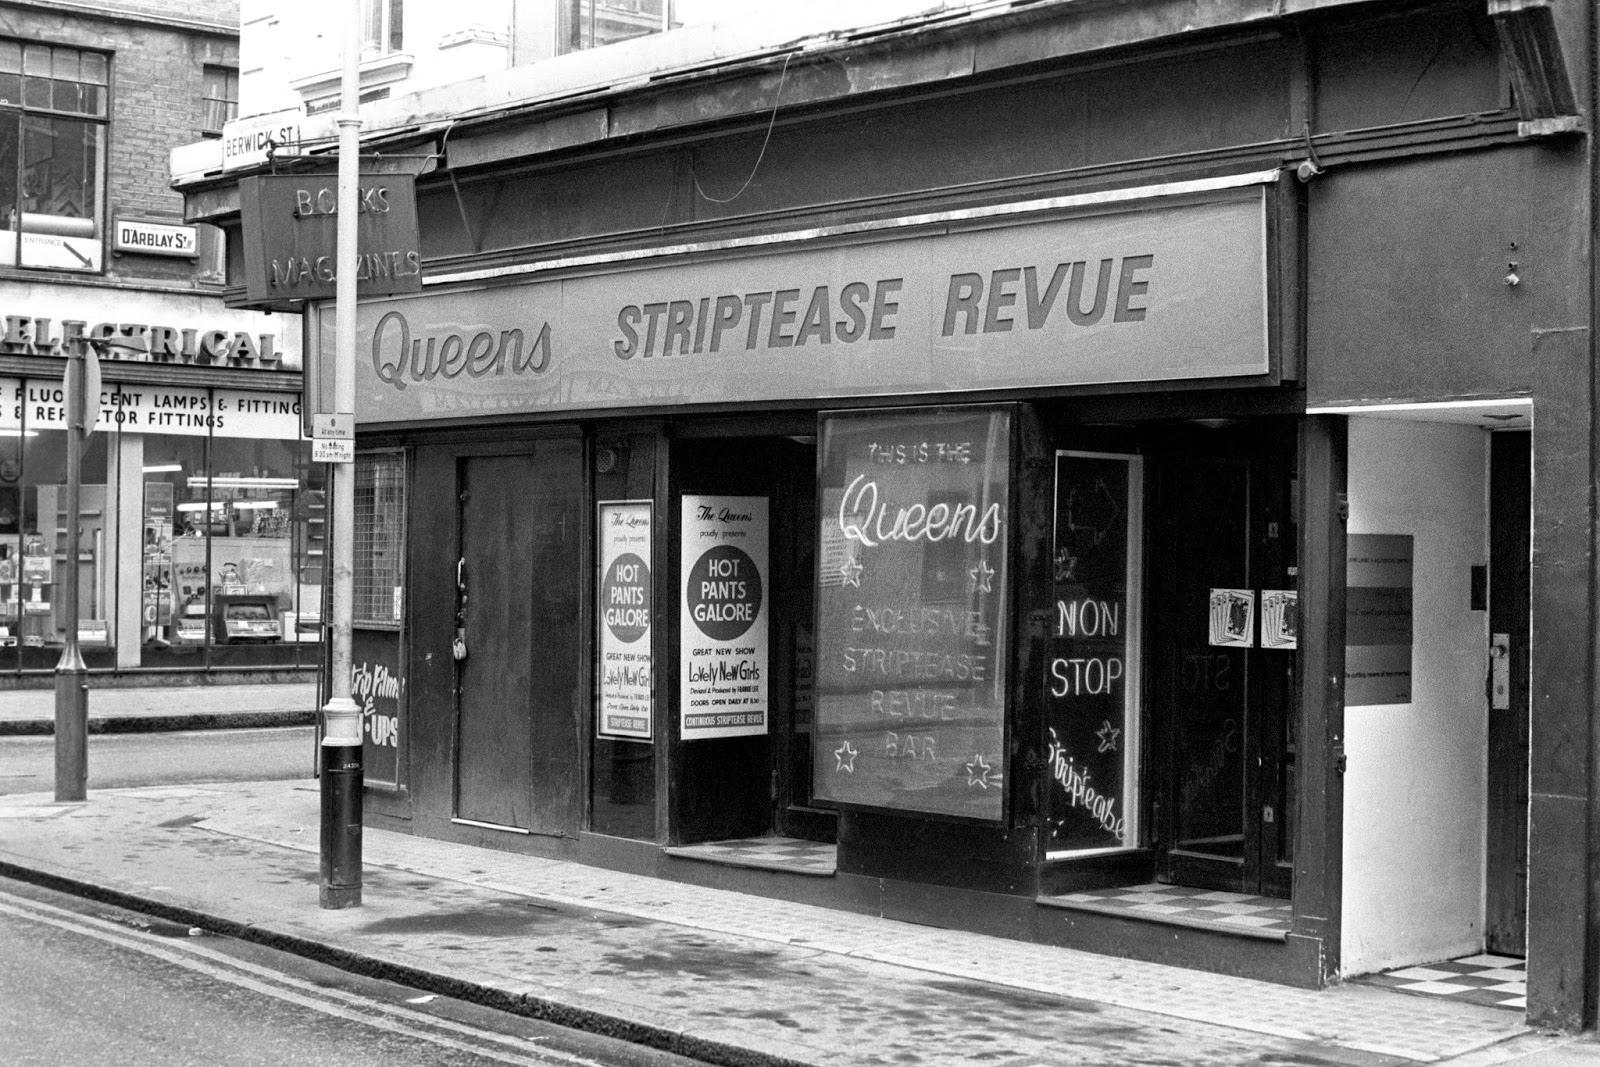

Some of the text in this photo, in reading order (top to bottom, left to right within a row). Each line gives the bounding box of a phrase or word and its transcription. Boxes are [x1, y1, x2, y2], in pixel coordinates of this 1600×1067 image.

[226, 130, 273, 158] BERWICK
[296, 187, 391, 217] BOKS
[24, 236, 63, 247] ENTRANCE
[271, 250, 420, 286] MAGZINES
[371, 253, 1155, 391] Queens STRIPTEASE REVUE
[3, 314, 283, 362] ELCTRICAL
[15, 387, 142, 407] FLUOCENT
[154, 394, 207, 410] LAMPS
[218, 398, 228, 411] &
[36, 406, 138, 424] REFTOR
[148, 411, 225, 428] FITTINGS
[697, 505, 752, 523] The Queens
[839, 474, 1001, 547] Queens
[700, 530, 718, 540] proudly
[616, 564, 639, 582] HOT
[708, 558, 741, 577] HOT
[611, 586, 644, 605] PANTS
[701, 581, 747, 600] PANTS
[606, 608, 649, 627] GALORE
[694, 603, 753, 622] GALORE
[1057, 599, 1119, 637] NON
[606, 652, 622, 661] GREAT
[623, 653, 635, 662] NEW
[692, 647, 756, 657] GREAT NEW SHOW
[843, 647, 987, 681] STRIPTEASE
[1051, 658, 1123, 698] STOP
[871, 690, 955, 721] REVUE
[685, 713, 764, 727] CONTINUOUS STRIPTEASE REVUE
[885, 730, 936, 760] BAR
